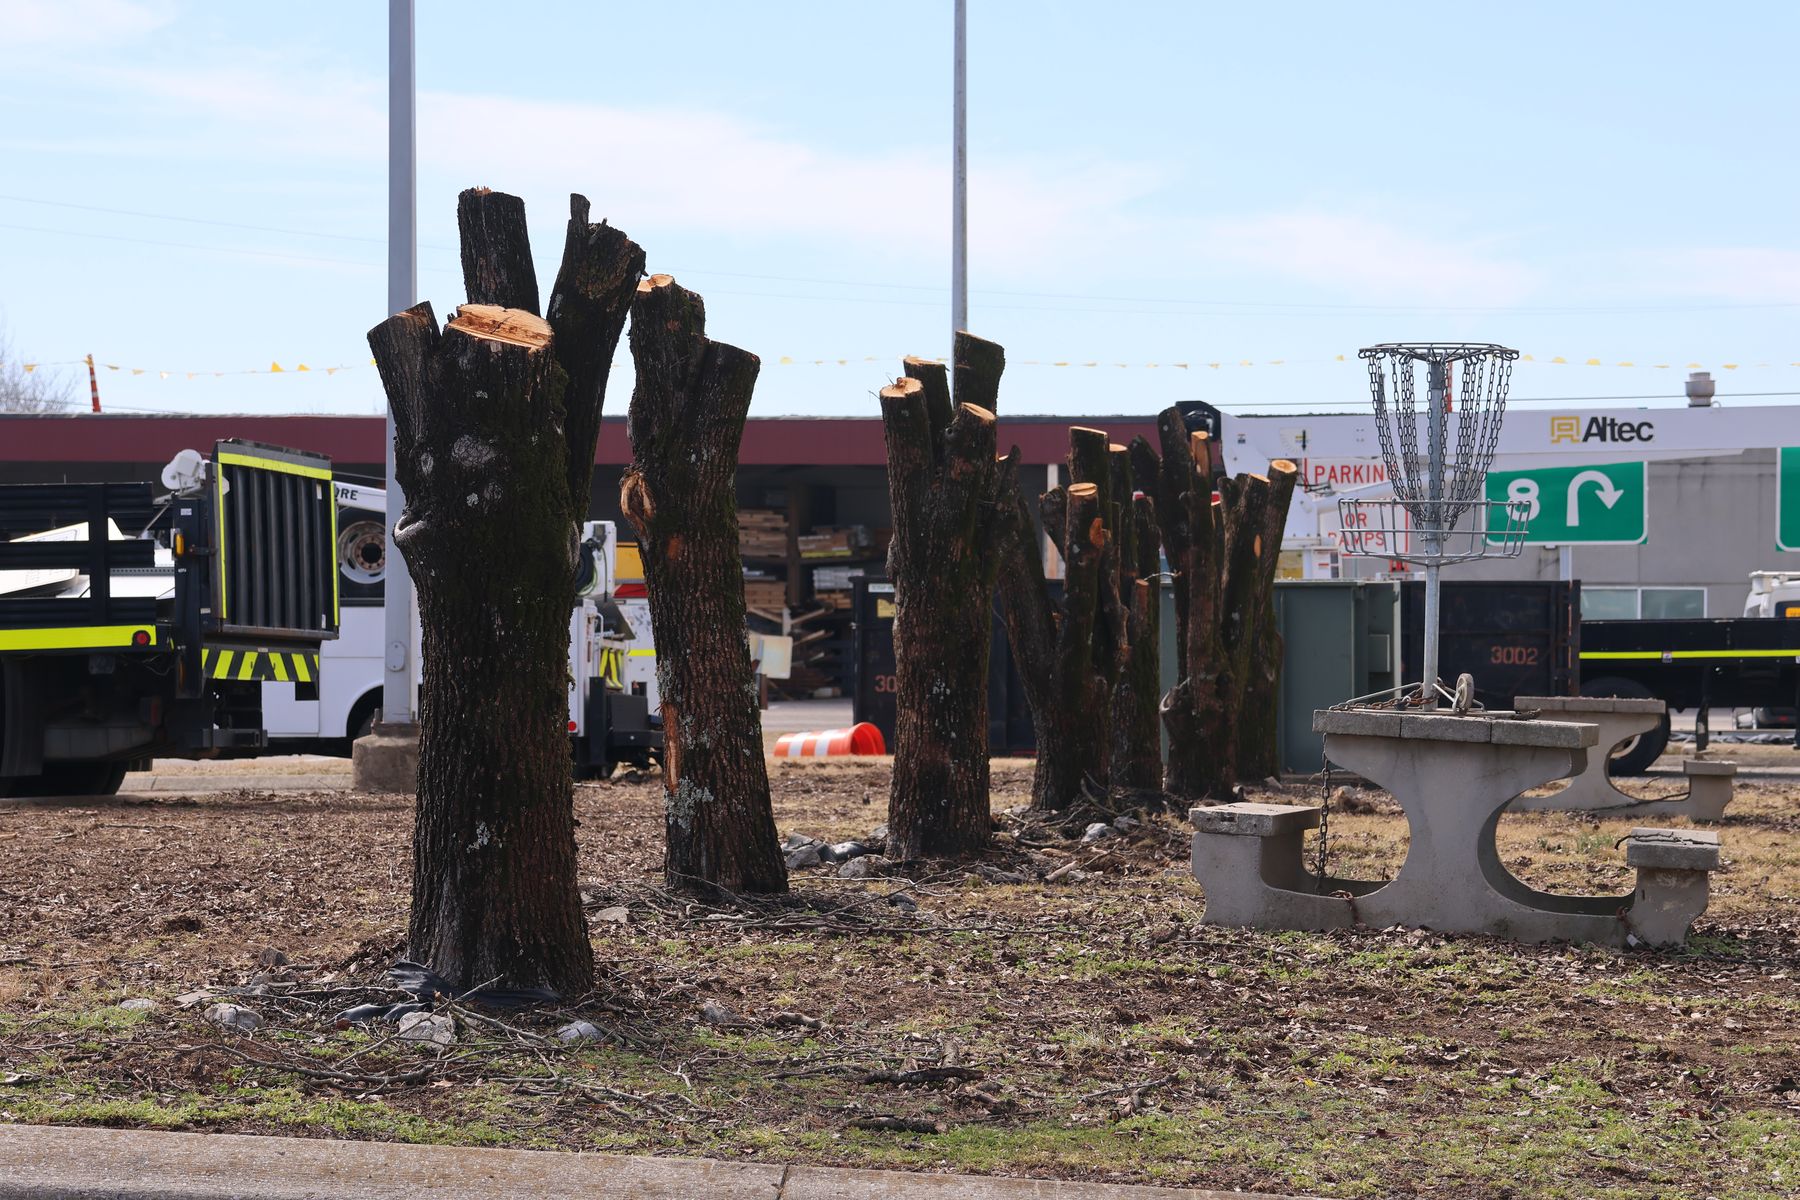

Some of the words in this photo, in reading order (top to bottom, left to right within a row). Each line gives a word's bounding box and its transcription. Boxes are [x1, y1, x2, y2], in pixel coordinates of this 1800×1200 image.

[1582, 416, 1654, 443] Altec
[1506, 478, 1541, 522] 8
[1345, 512, 1368, 528] OR
[1328, 531, 1385, 546] APS
[1490, 645, 1538, 665] 3002
